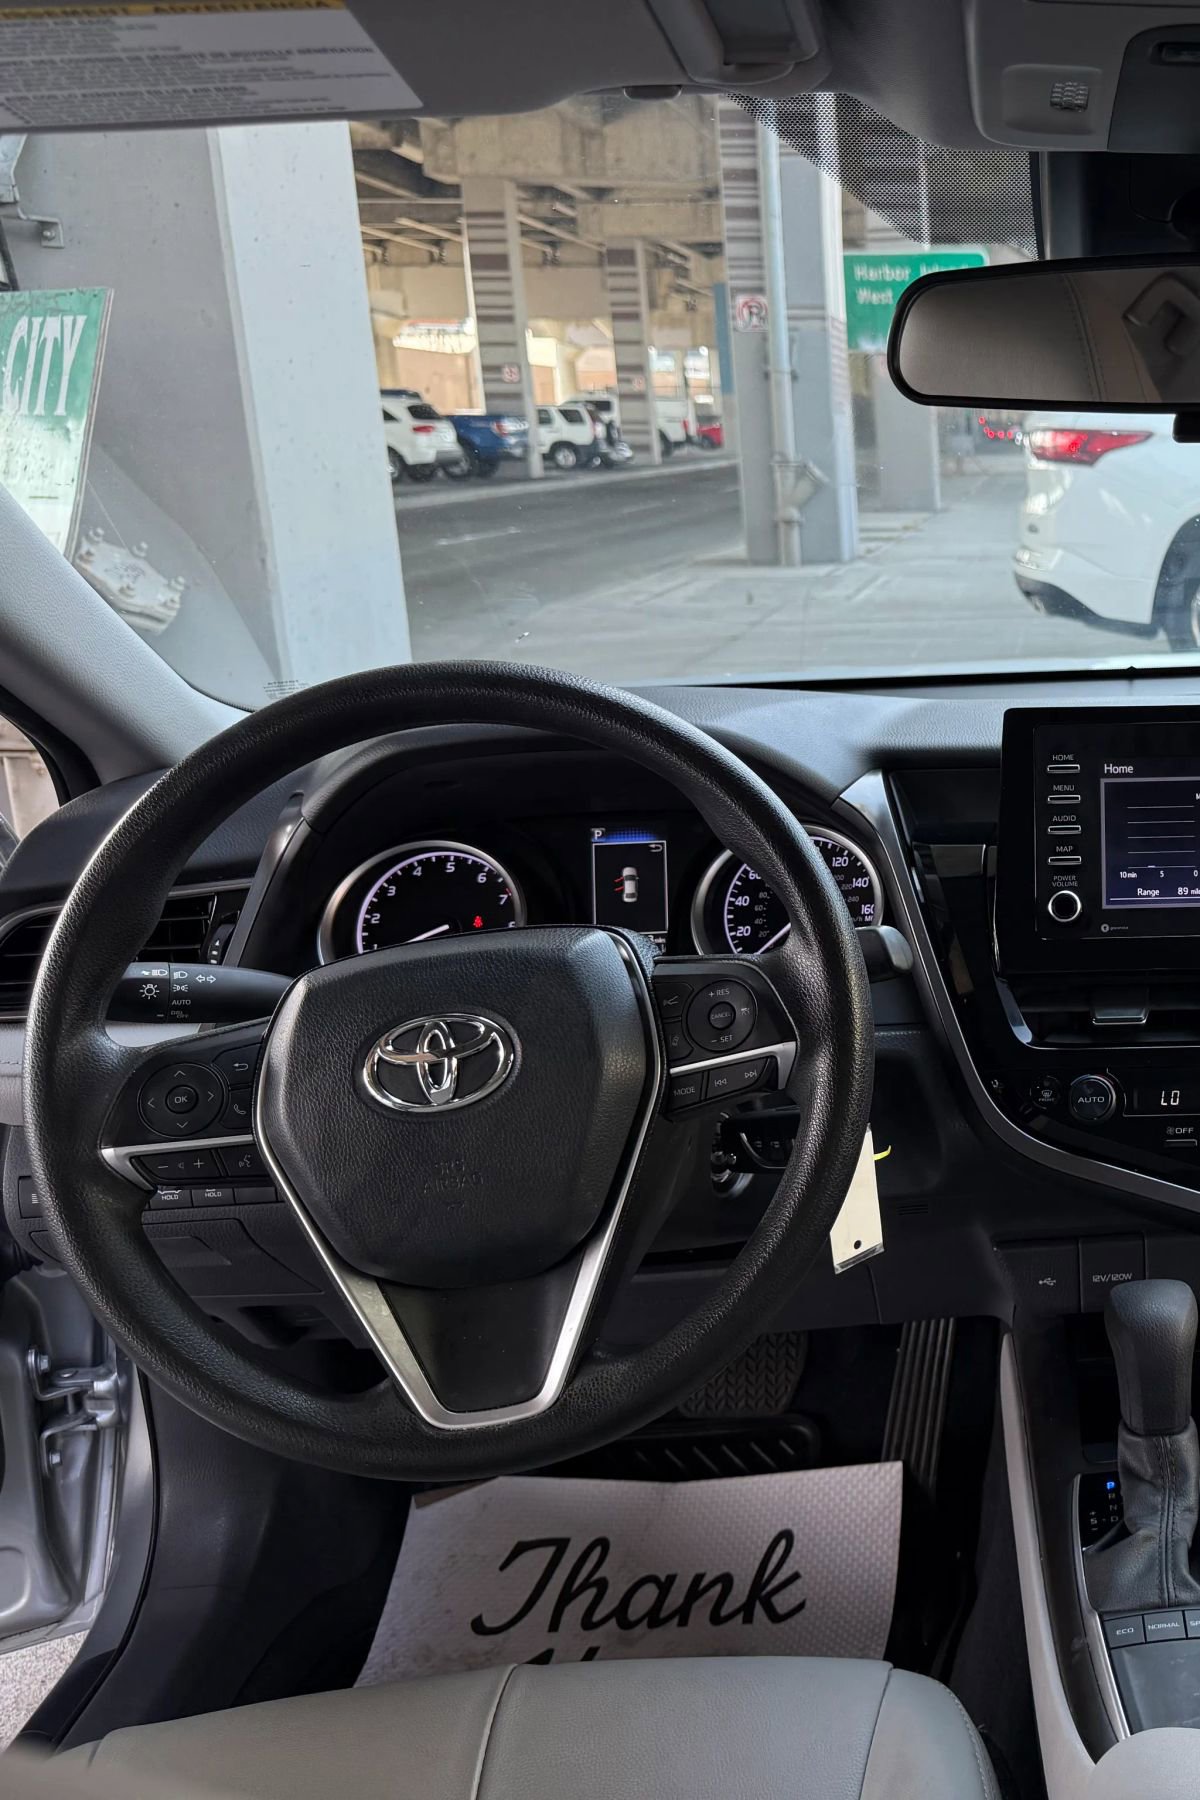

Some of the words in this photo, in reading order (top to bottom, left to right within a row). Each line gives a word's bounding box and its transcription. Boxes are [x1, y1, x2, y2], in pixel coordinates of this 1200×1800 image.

[3, 314, 88, 417] CITY
[1104, 763, 1134, 774] Home
[594, 829, 603, 839] P
[832, 857, 849, 867] 120
[413, 866, 422, 877] 4
[445, 862, 455, 873] 5
[477, 872, 487, 883] 6
[852, 878, 869, 888] 140
[387, 886, 397, 897] 3
[1137, 888, 1160, 897] Range
[1177, 887, 1189, 895] 89
[499, 893, 509, 905] 7
[734, 895, 750, 907] 40
[370, 913, 381, 924] 2
[736, 926, 751, 937] 20
[716, 988, 730, 996] RES
[720, 1034, 733, 1043] SET
[174, 1095, 188, 1104] OK
[1175, 1126, 1194, 1134] OFF
[1092, 1273, 1133, 1283] 12V/120W
[1106, 1481, 1116, 1490] P
[470, 1527, 807, 1637] Thank
[1147, 1621, 1180, 1630] NORMAL
[1116, 1627, 1135, 1635] ECO
